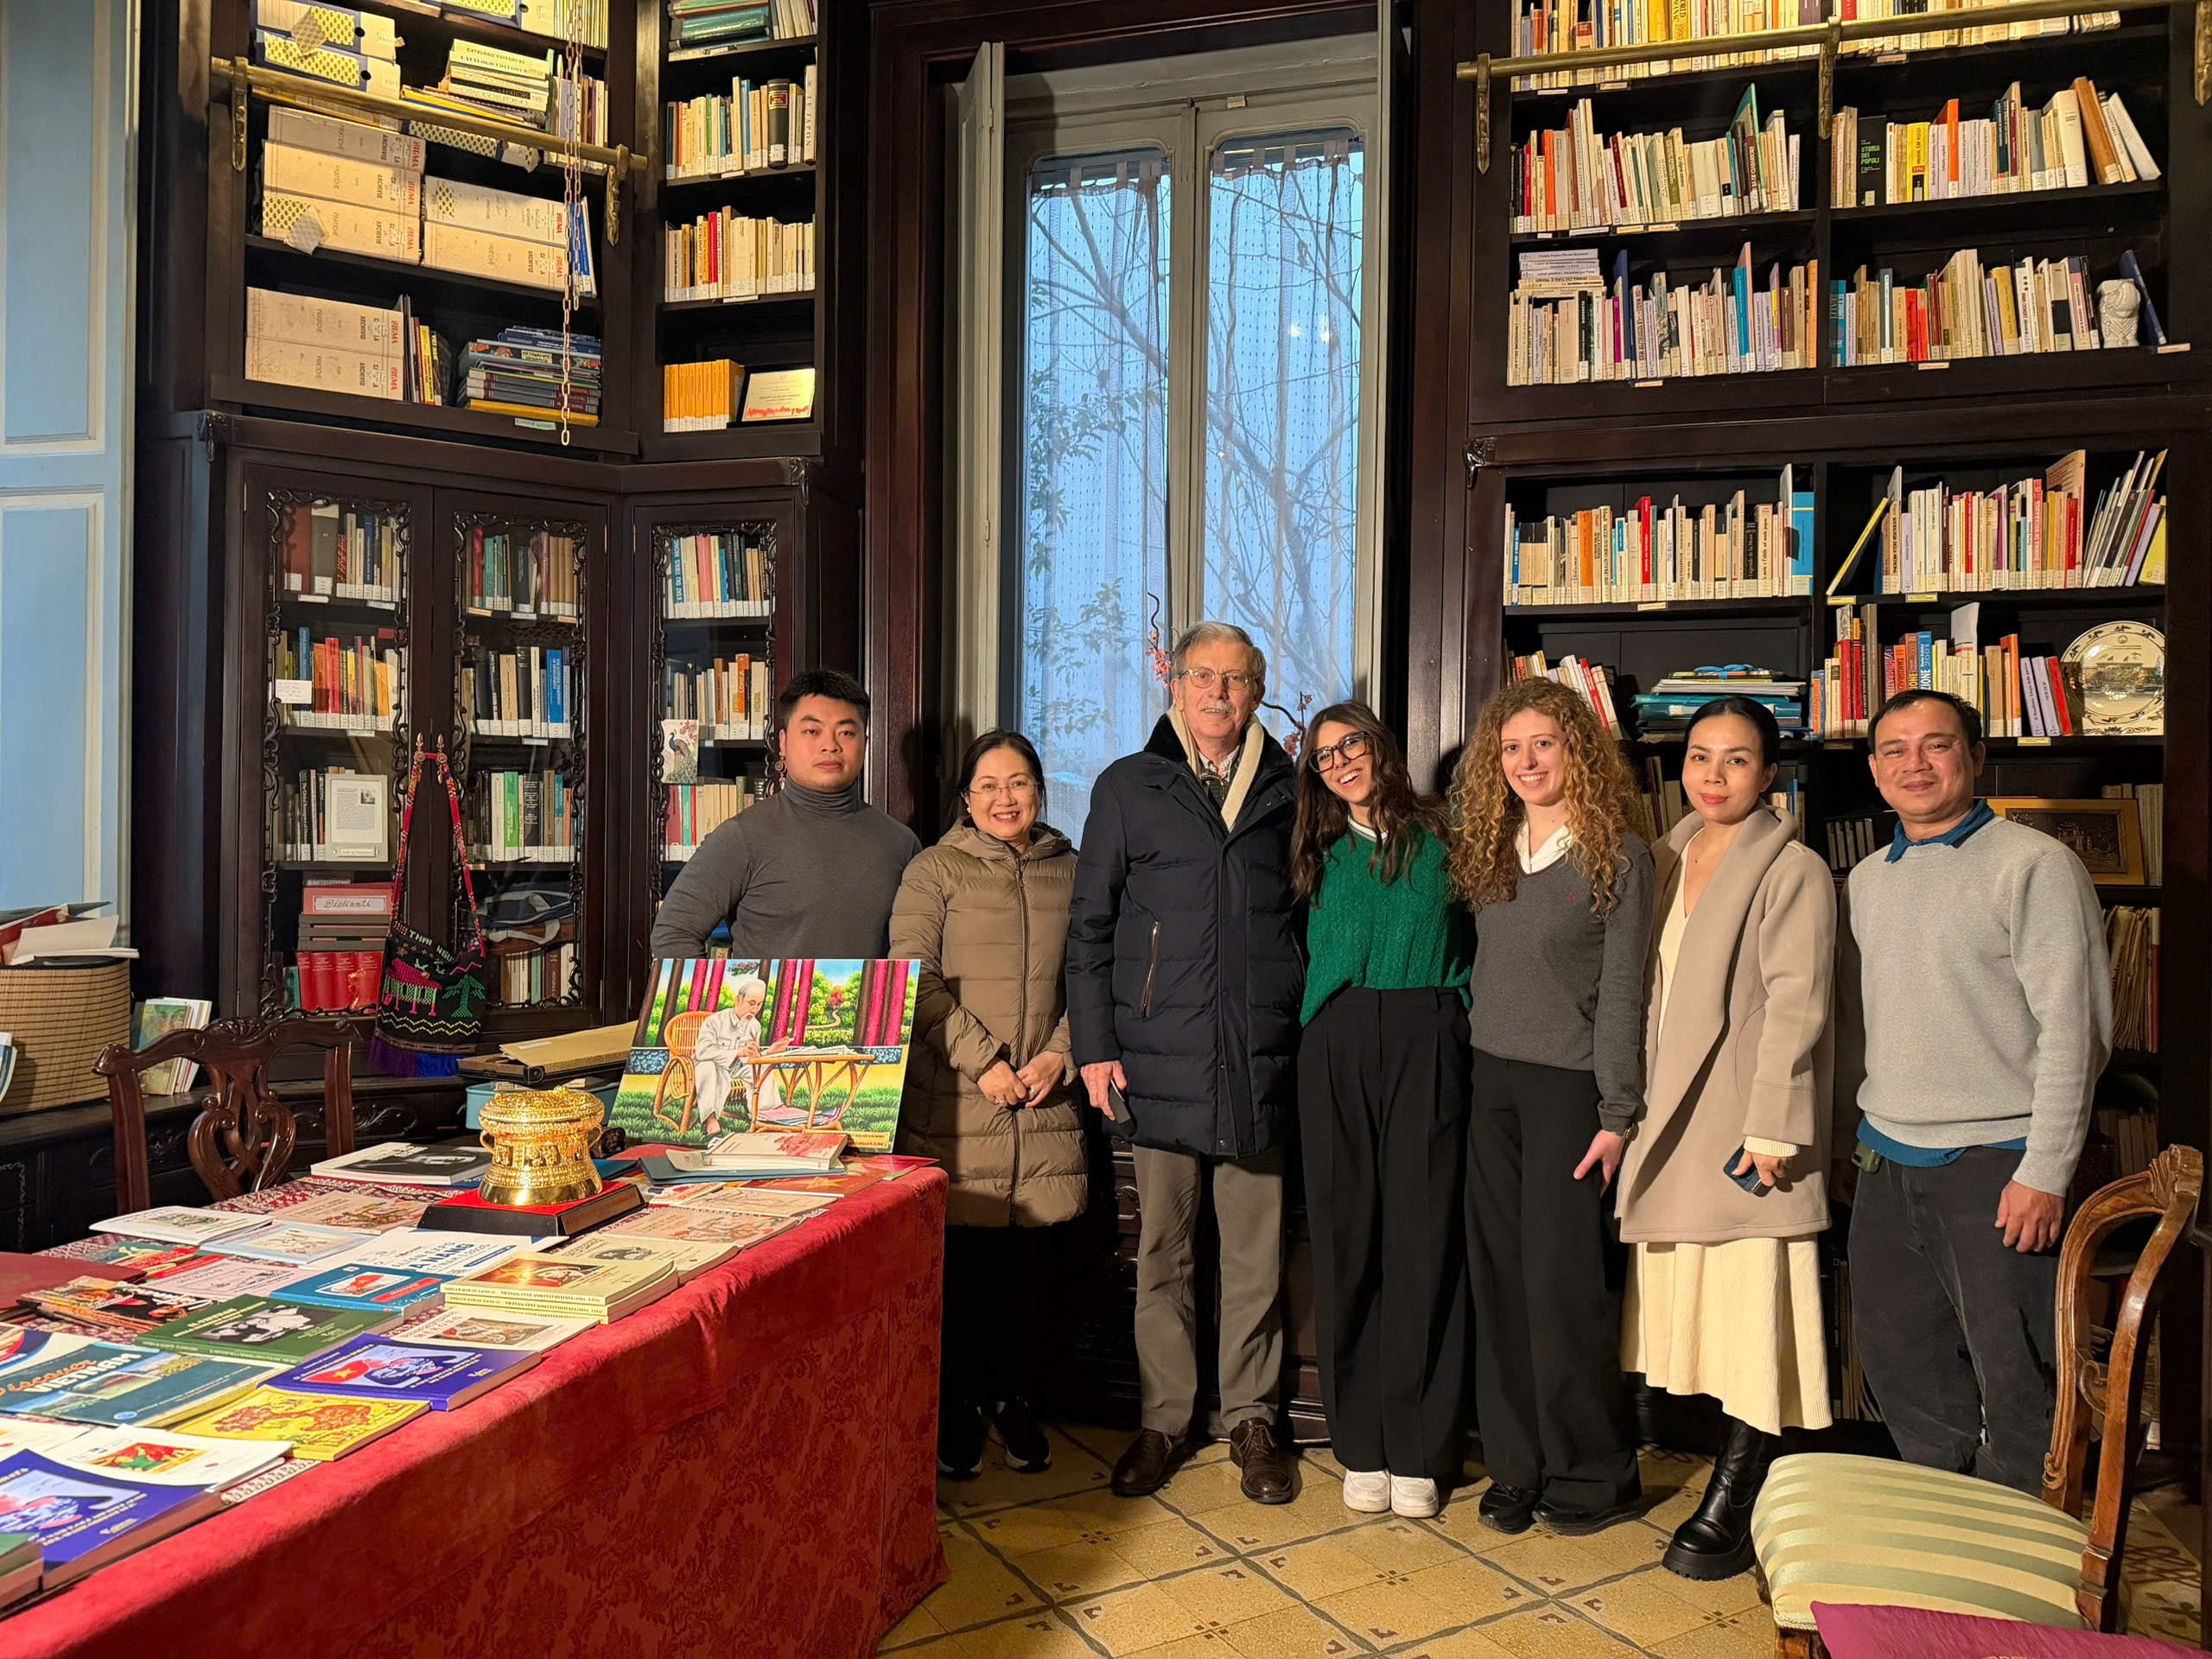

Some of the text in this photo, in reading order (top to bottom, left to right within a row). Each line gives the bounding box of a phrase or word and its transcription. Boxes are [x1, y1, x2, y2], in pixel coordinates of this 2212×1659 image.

[467, 47, 496, 58] CATALOGO
[496, 54, 518, 64] EDITORI
[411, 141, 421, 168] SIGMA
[323, 898, 372, 909] Dépliants
[408, 930, 433, 947] THAI
[24, 1353, 142, 1393] VIETNAM
